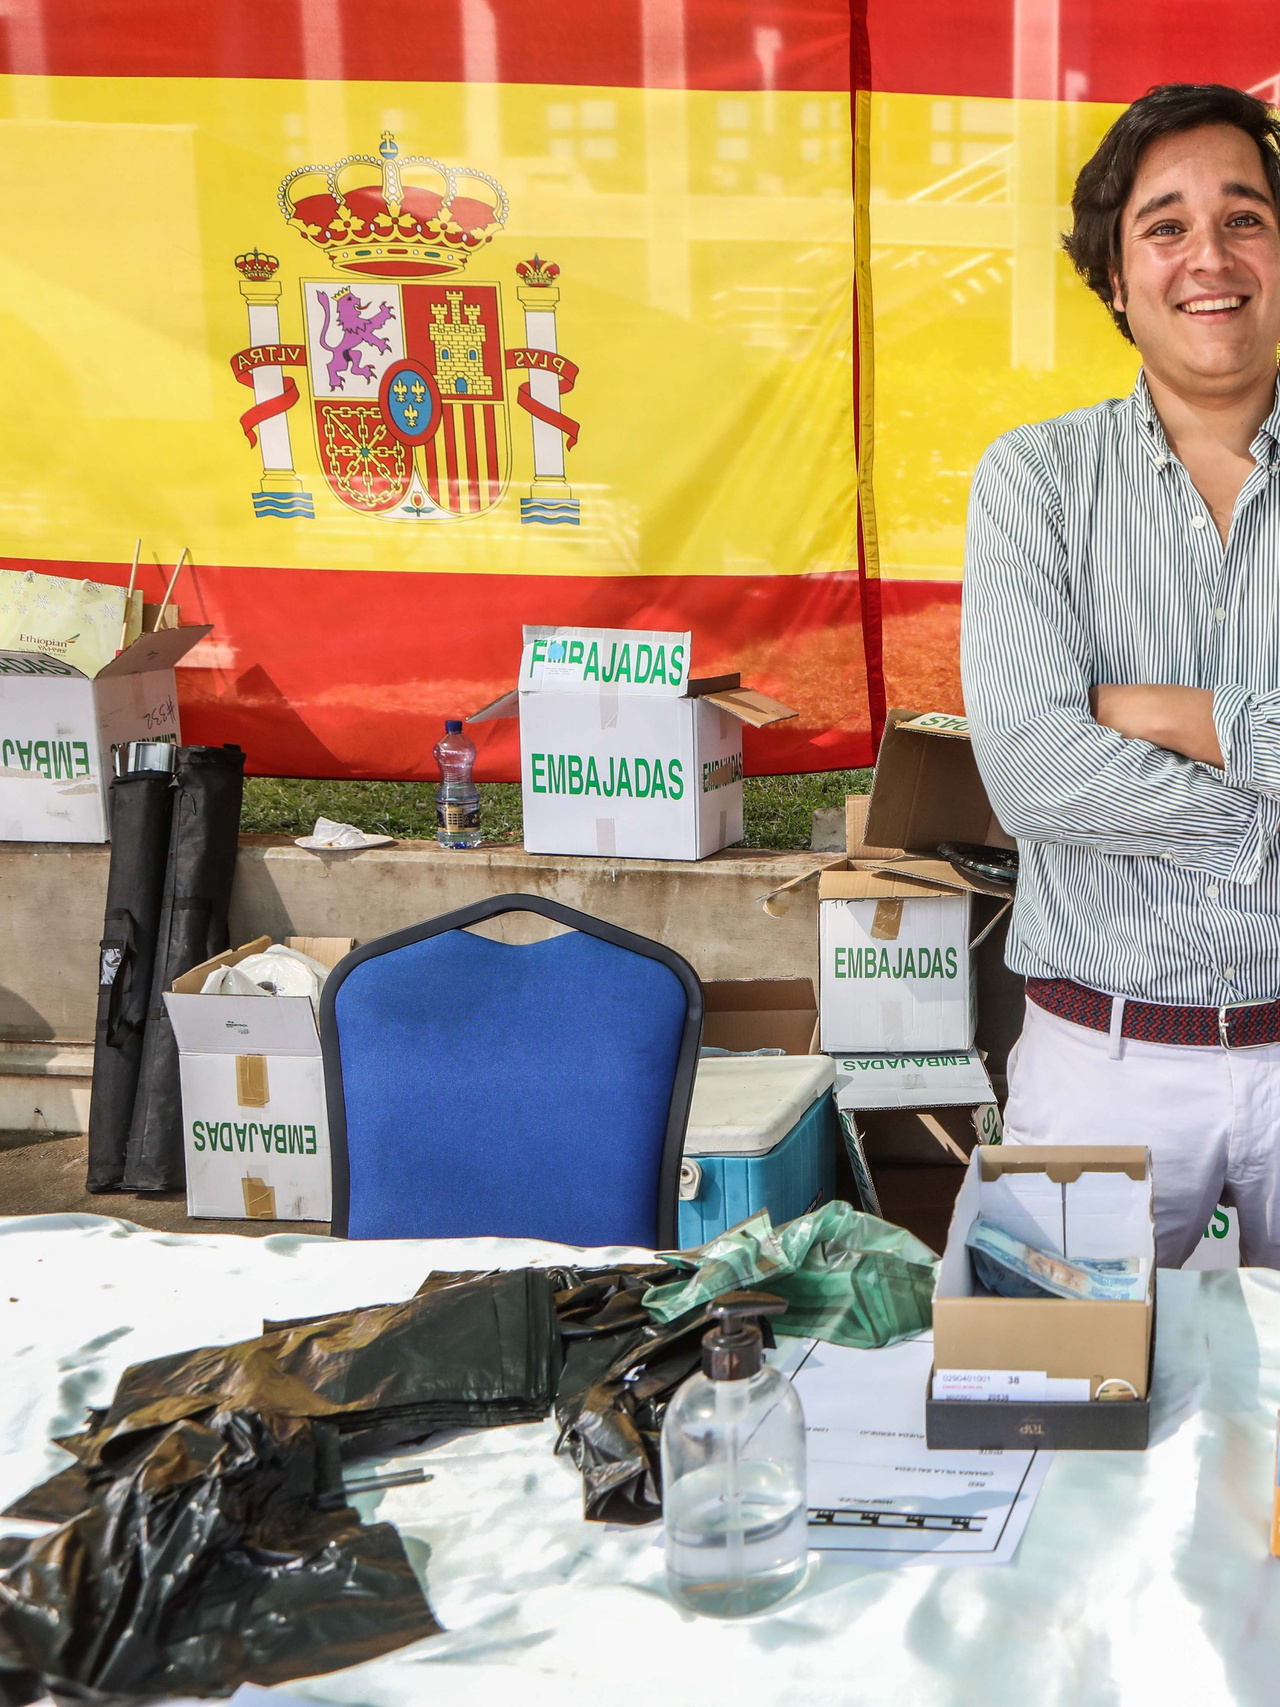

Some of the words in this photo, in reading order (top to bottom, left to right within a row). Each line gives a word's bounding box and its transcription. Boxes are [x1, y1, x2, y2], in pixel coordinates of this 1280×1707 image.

[20, 633, 67, 648] Ethiopian
[2, 738, 91, 780] EMBAJ
[531, 753, 684, 800] EMBAJADAS
[834, 946, 958, 980] EMBAJADAS
[843, 1055, 971, 1072] EMBAJADAS
[193, 1119, 317, 1155] EMBAJADAS
[1008, 1376, 1020, 1385] 38
